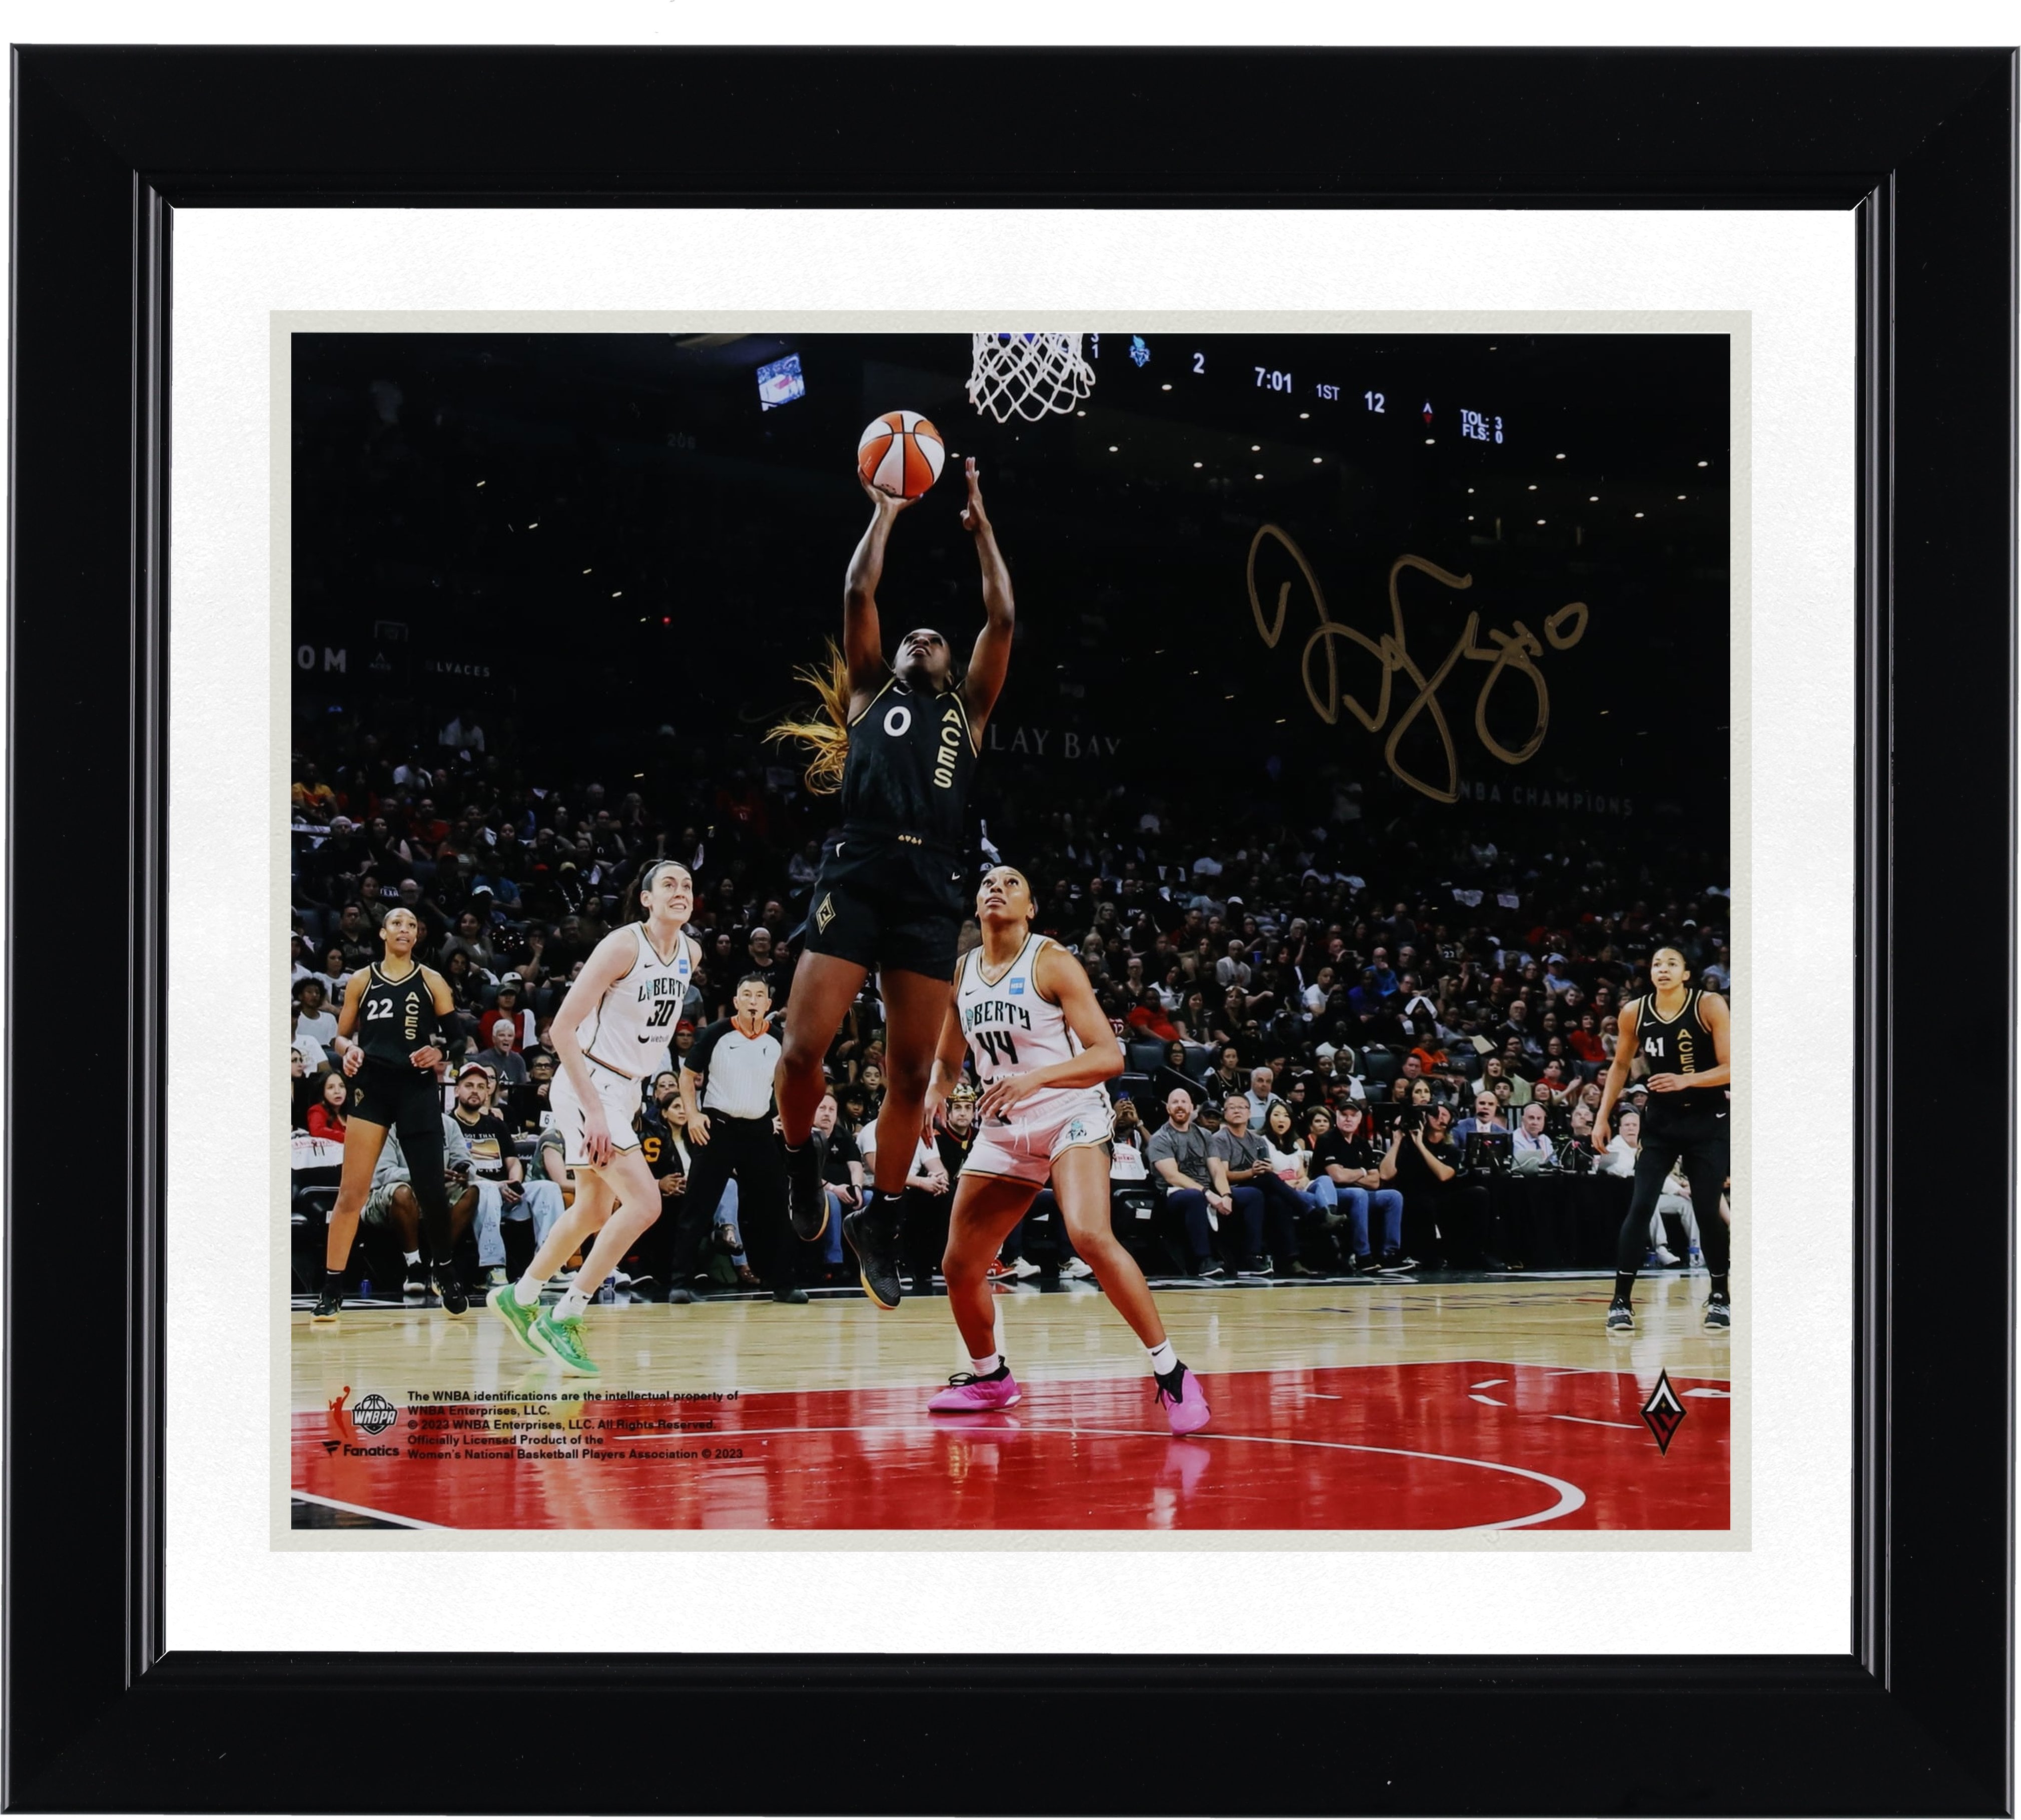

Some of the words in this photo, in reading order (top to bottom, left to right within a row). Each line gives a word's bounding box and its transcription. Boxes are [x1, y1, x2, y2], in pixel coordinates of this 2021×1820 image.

[1091, 344, 1098, 359] 1
[1193, 352, 1205, 374] 2
[1254, 366, 1291, 393] 7:01
[1316, 383, 1340, 401] 1ST
[1364, 390, 1385, 413] 12
[1460, 408, 1490, 428] TOL:
[1494, 416, 1503, 430] 3
[1462, 423, 1490, 442] FLS:
[1495, 430, 1504, 444] 0
[436, 661, 490, 677] LVACES
[883, 705, 912, 737] 0
[933, 708, 963, 789] ACES
[1513, 786, 1633, 818] CHAMPIONS
[367, 998, 394, 1021] 22
[404, 991, 421, 1040] ACES
[646, 1000, 676, 1026] 30
[976, 1031, 1018, 1065] 44
[1645, 1036, 1665, 1057] 41
[1677, 1028, 1696, 1073] ACES
[643, 1136, 662, 1163] S
